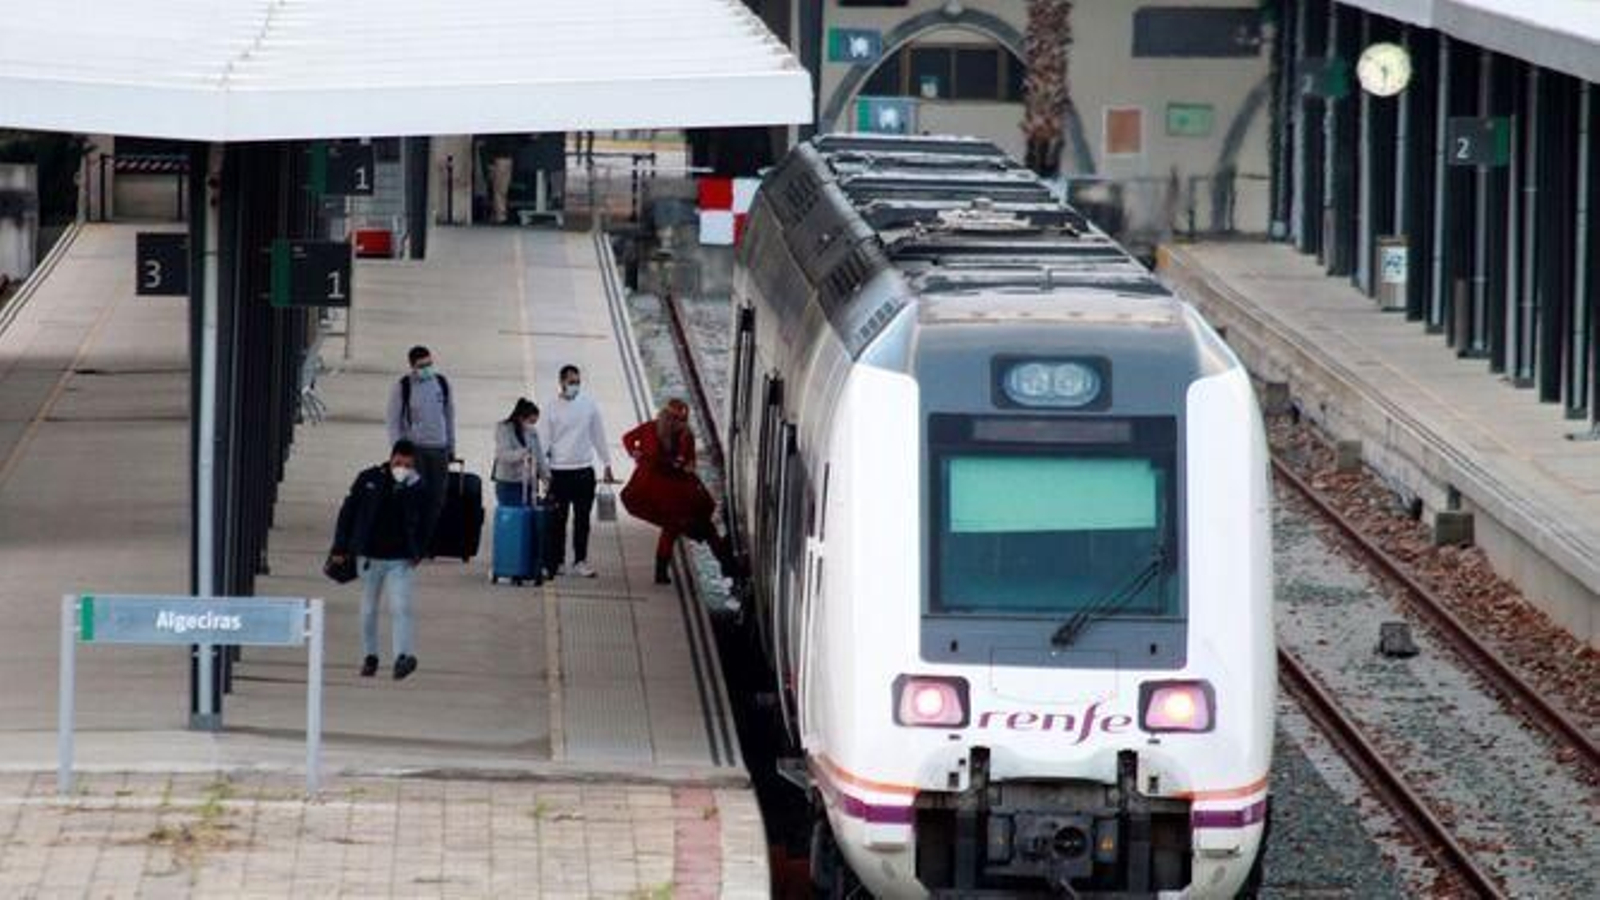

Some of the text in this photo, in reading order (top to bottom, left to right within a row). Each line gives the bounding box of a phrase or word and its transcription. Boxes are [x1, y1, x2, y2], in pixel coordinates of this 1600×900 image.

[1457, 138, 1469, 159] 2
[355, 166, 369, 190] 1
[145, 260, 161, 288] 3
[327, 271, 345, 299] 1
[156, 611, 242, 633] Algeciras
[978, 702, 1132, 745] renfe
